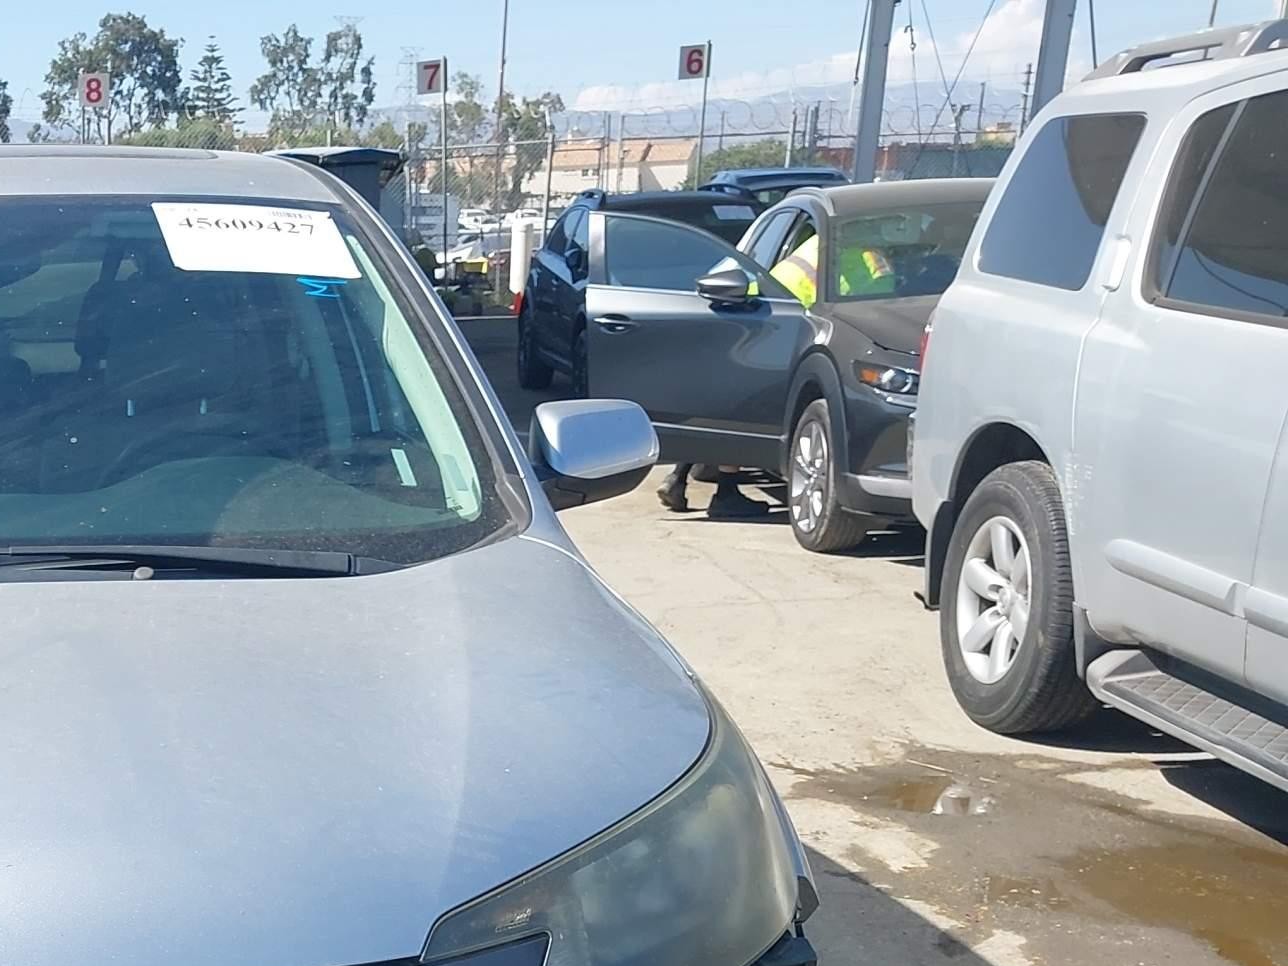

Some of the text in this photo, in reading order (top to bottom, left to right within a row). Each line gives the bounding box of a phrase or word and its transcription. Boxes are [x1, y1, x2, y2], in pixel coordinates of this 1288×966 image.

[685, 48, 704, 76] 6
[423, 63, 441, 90] 7
[85, 77, 103, 103] 8
[178, 217, 315, 236] 45609427
